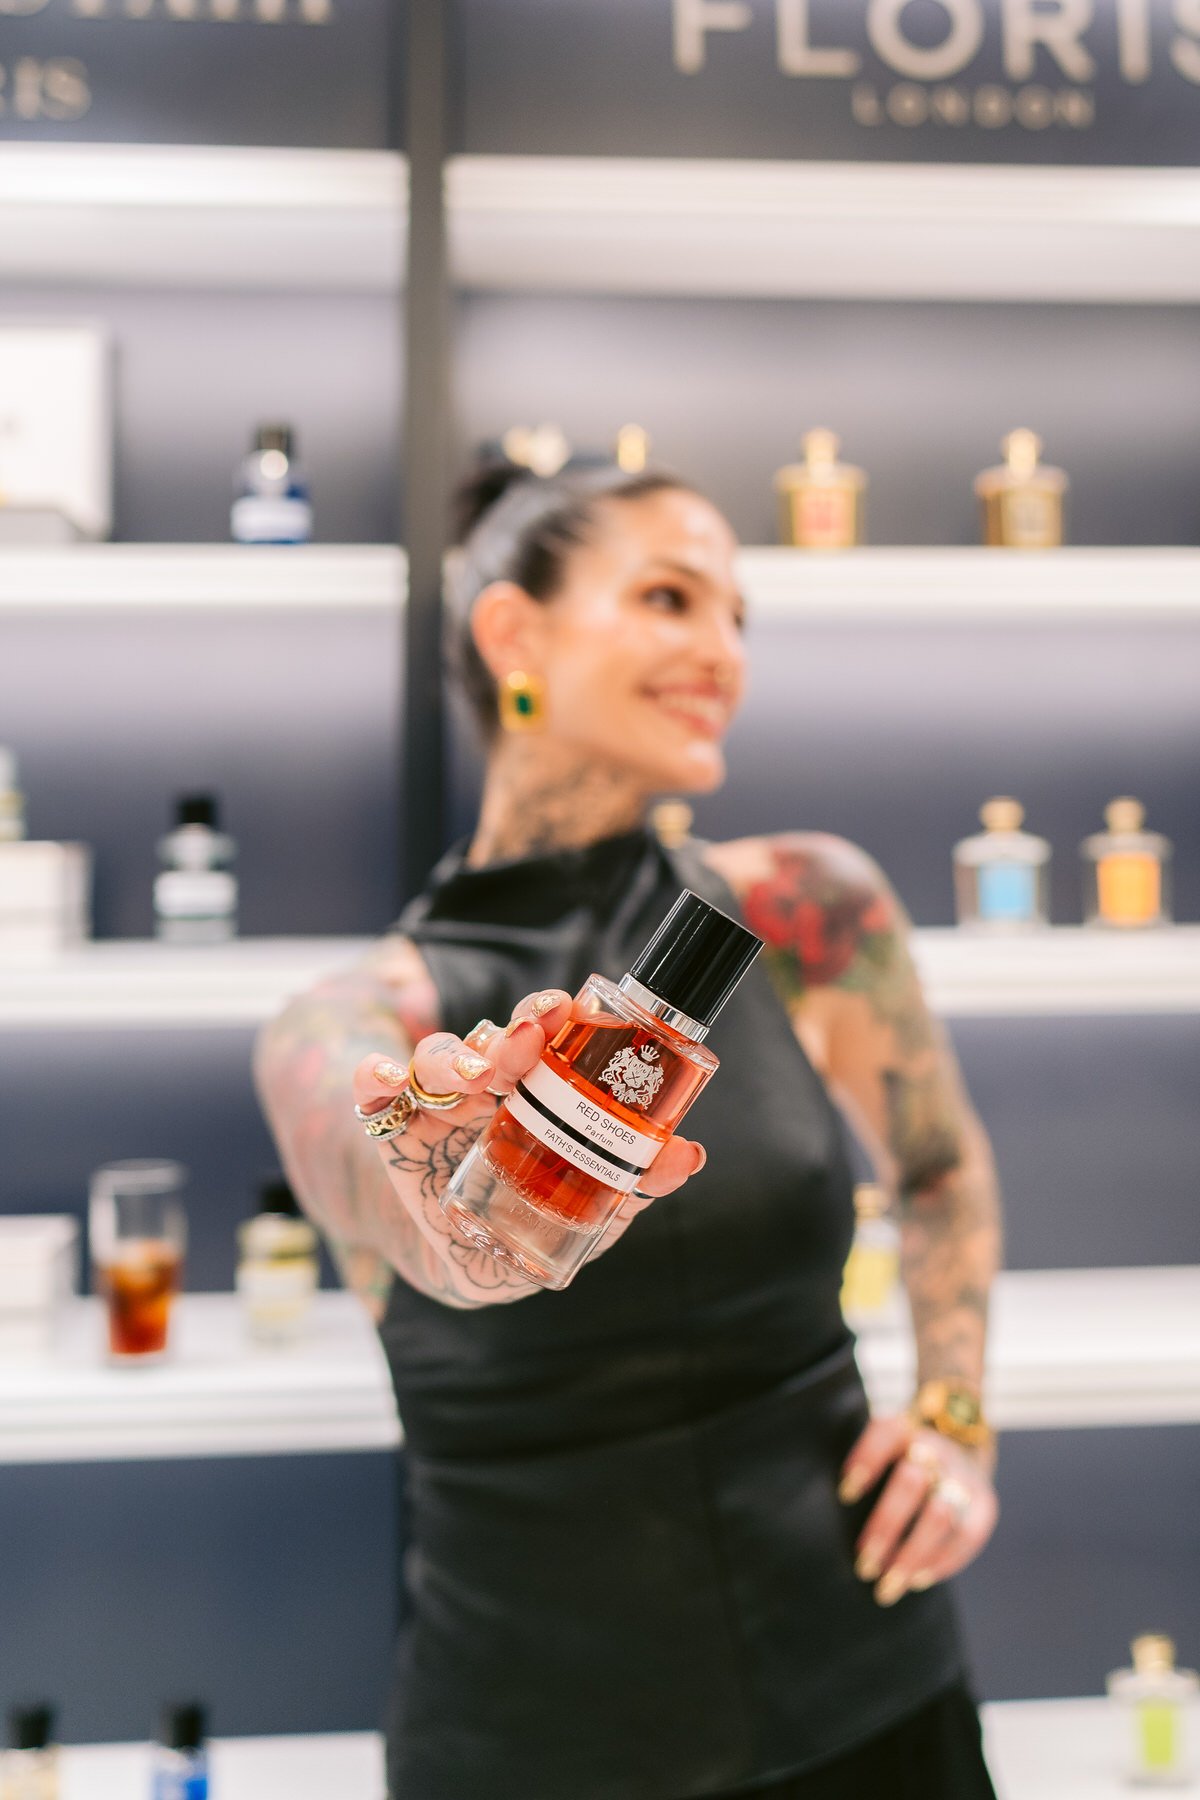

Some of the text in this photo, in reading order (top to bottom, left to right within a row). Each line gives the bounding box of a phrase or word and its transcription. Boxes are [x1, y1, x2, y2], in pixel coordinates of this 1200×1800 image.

[576, 1101, 637, 1145] RED SHOES
[585, 1124, 614, 1147] Parfum
[544, 1128, 621, 1182] FATH'S ESSENTIALS
